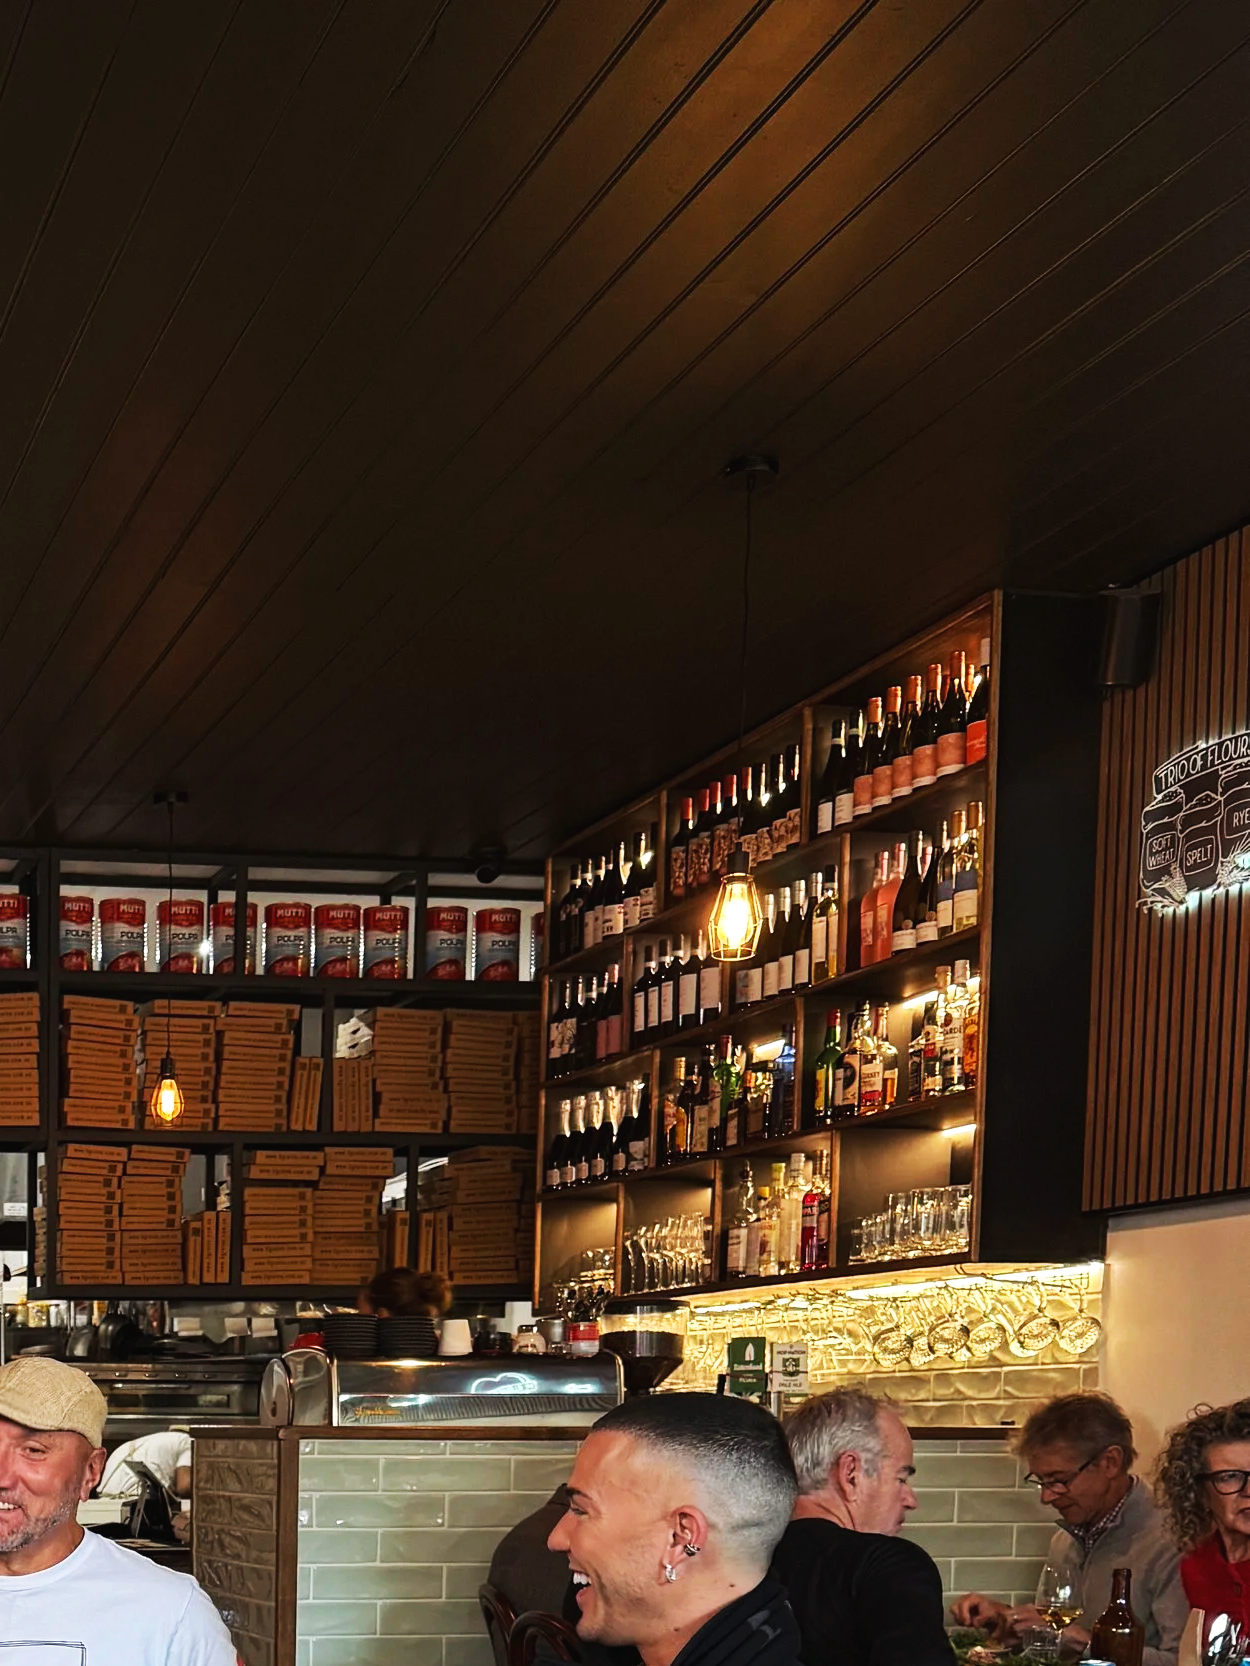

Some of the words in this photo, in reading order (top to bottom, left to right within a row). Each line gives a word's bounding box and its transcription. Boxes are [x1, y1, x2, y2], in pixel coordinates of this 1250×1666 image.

[1158, 760, 1187, 790] TRIO
[1189, 748, 1206, 773] OF
[1207, 735, 1250, 768] FLOUR
[1233, 808, 1250, 828] RYE
[1152, 835, 1171, 852] SOFT
[1149, 848, 1174, 868] WHEAT
[1186, 844, 1212, 867] SPELT
[171, 906, 199, 914] MUTTI
[172, 933, 198, 941] POLPA
